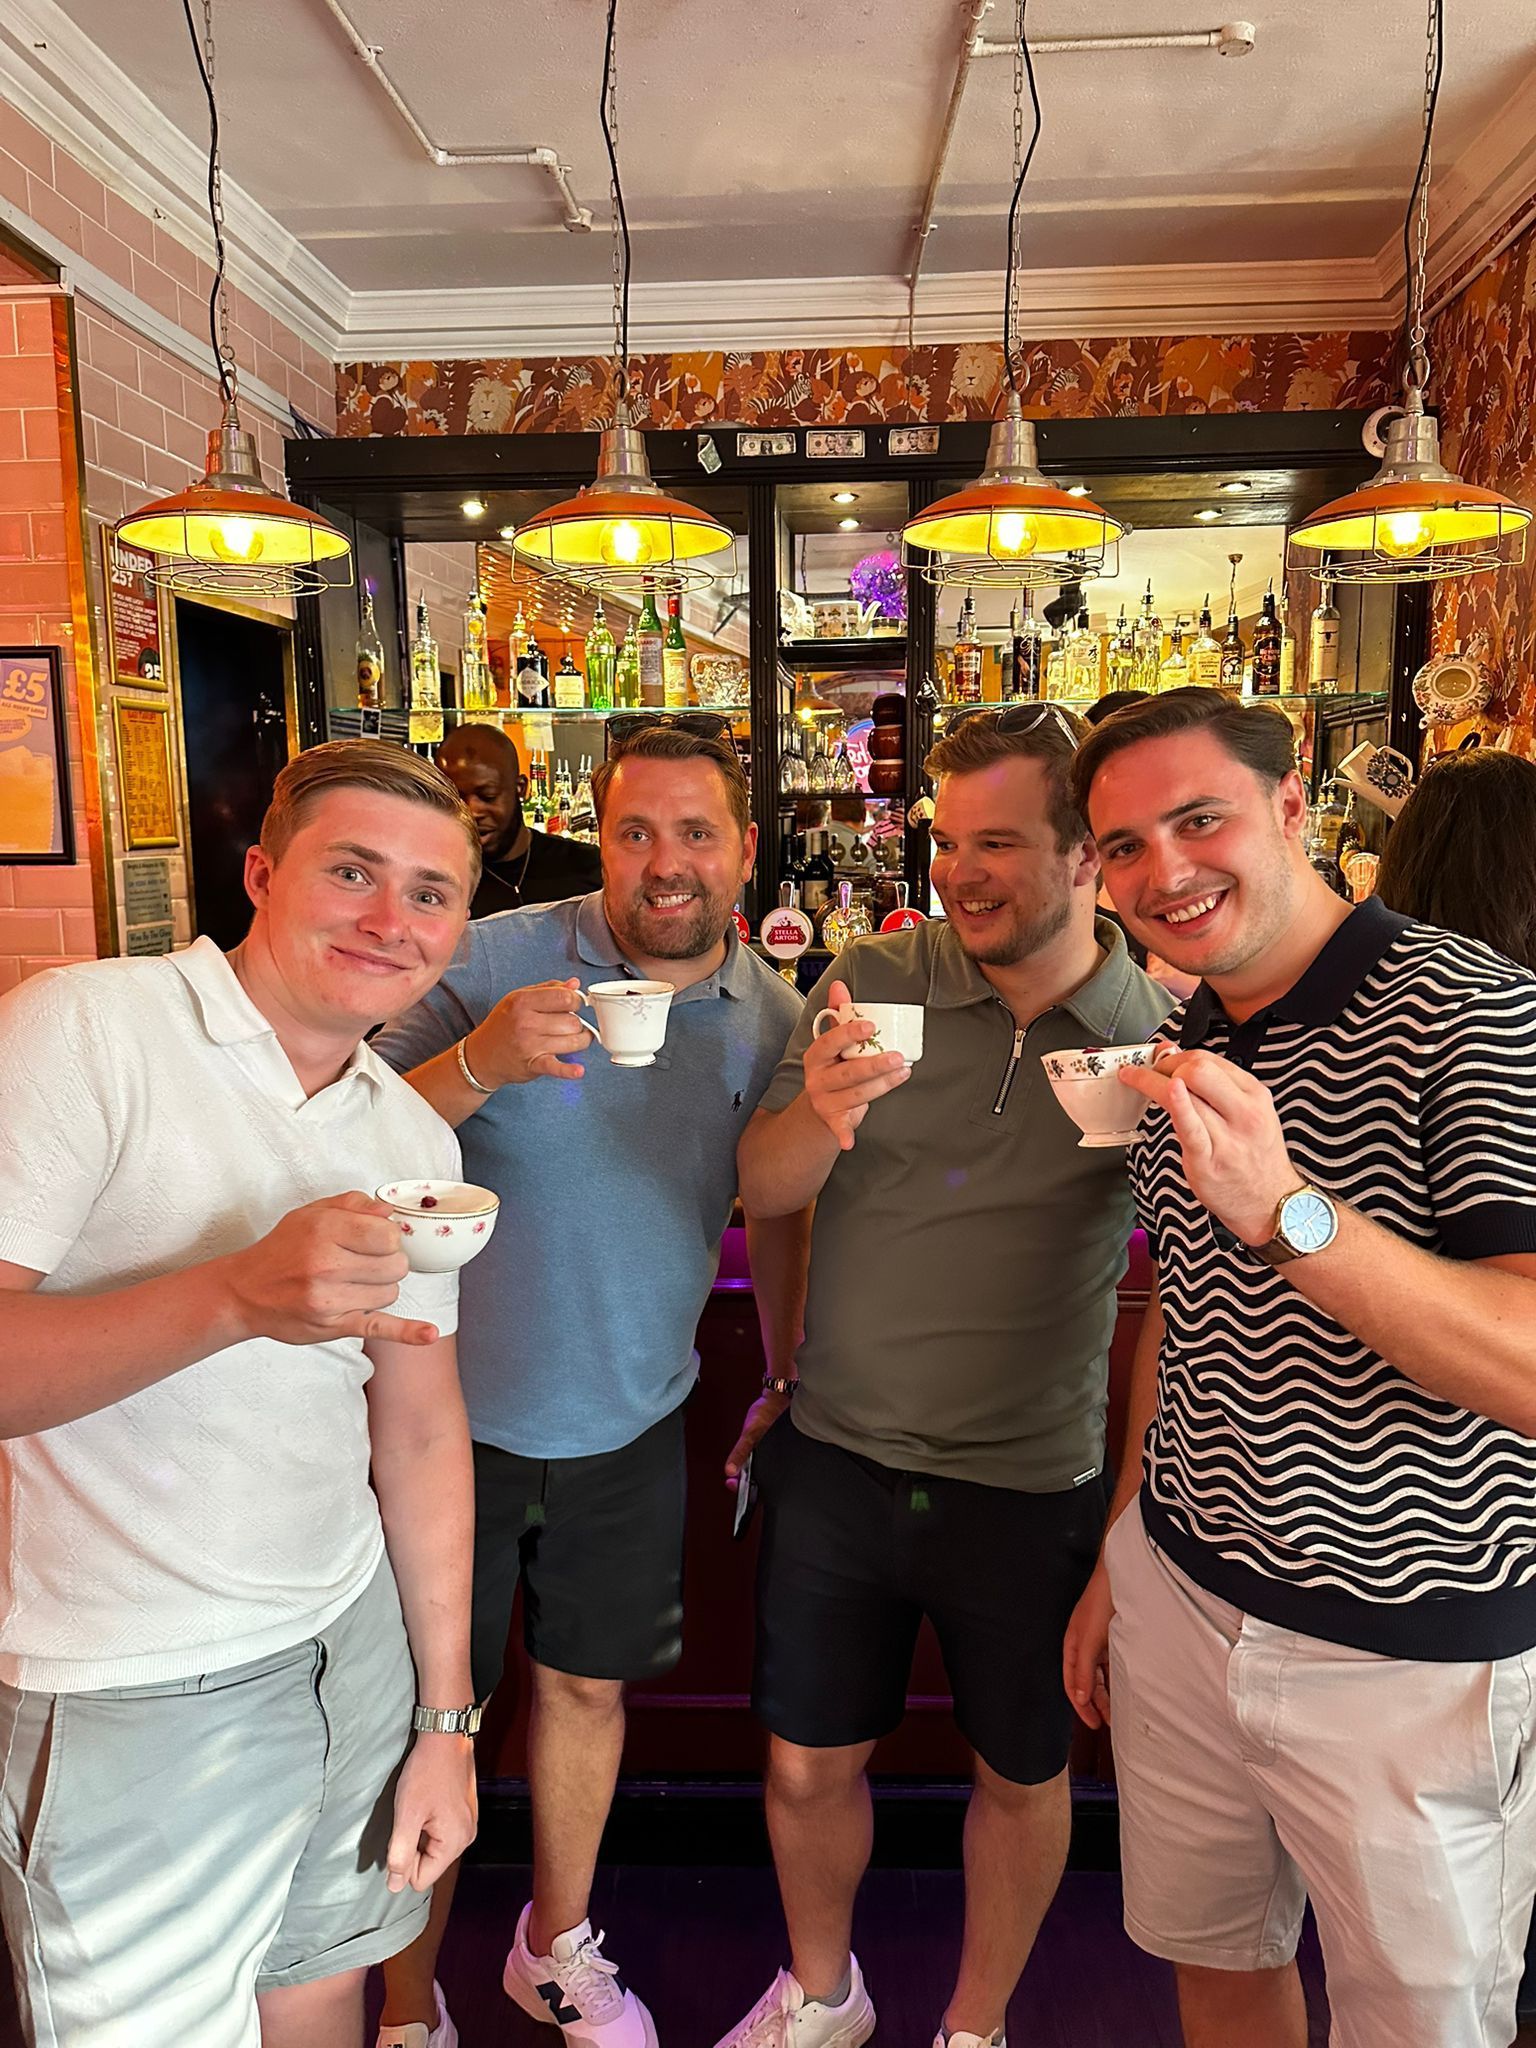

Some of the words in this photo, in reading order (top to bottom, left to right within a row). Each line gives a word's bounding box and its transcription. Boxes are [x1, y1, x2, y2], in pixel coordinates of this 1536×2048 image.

[111, 565, 134, 589] 25?
[3, 669, 48, 703] £5
[822, 928, 850, 943] NECK
